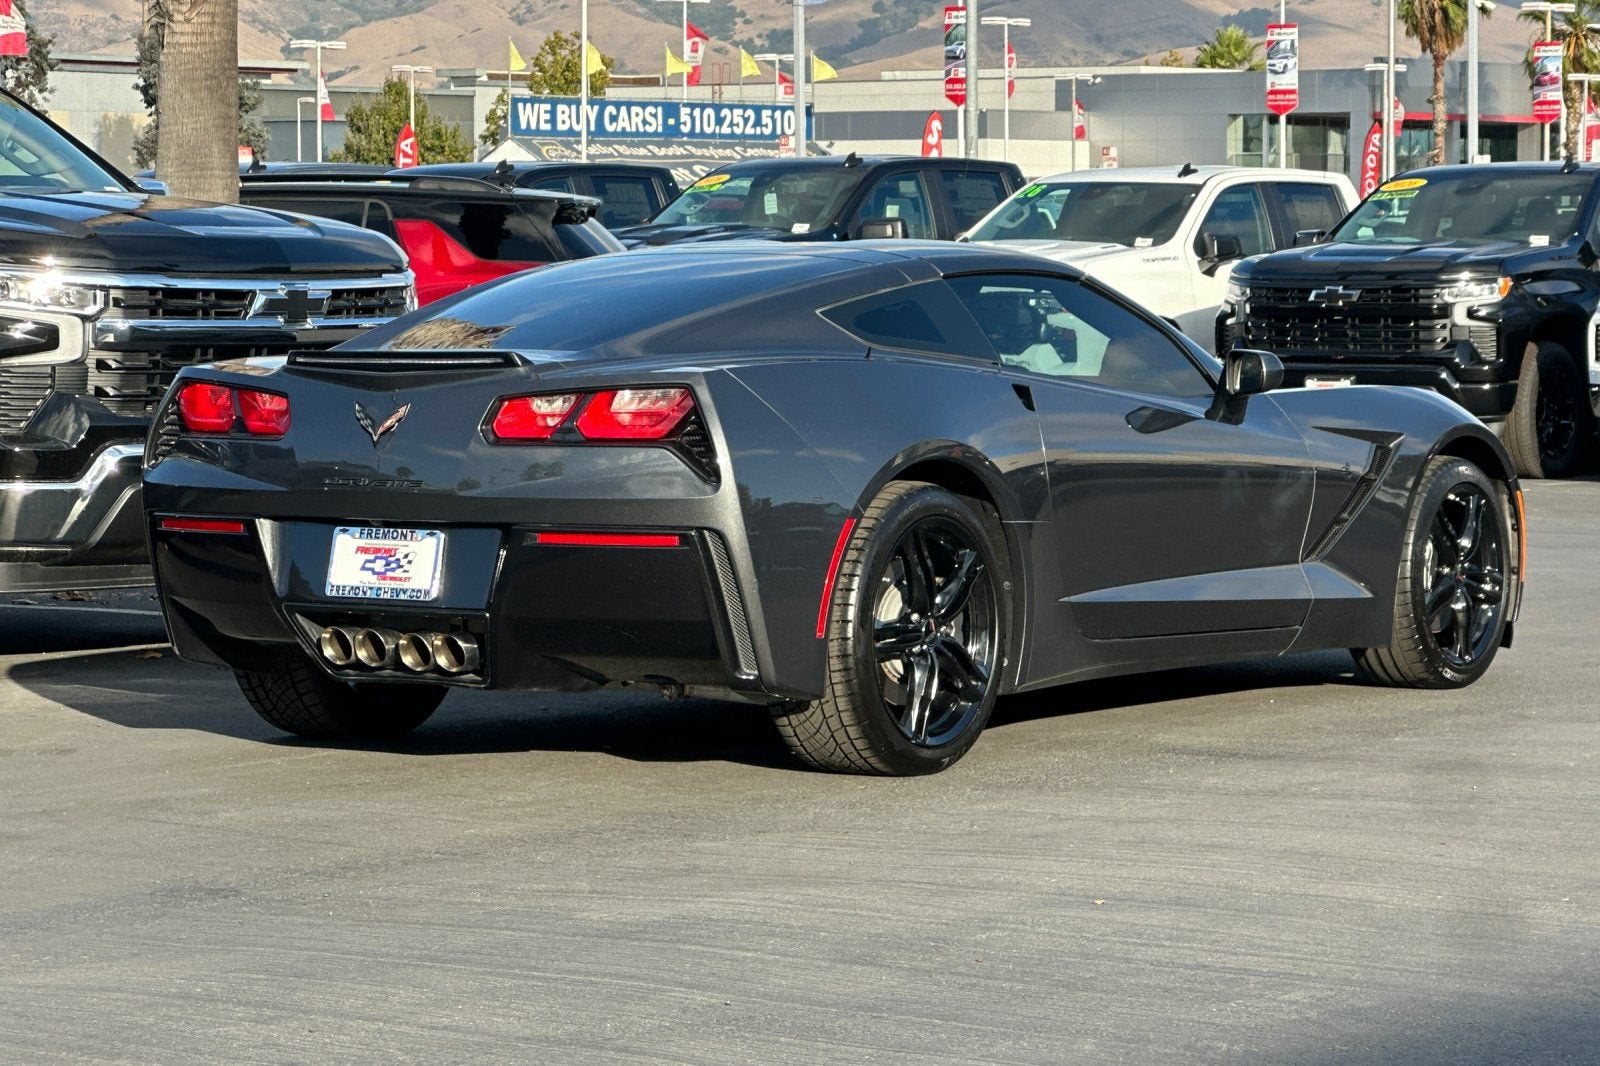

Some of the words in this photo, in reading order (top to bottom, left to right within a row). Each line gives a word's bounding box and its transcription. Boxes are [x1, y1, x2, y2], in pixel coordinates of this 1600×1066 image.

[518, 102, 551, 130] WE
[556, 103, 599, 131] BUY
[603, 105, 663, 133] CARS!
[680, 107, 796, 135] 510.252.510
[359, 529, 416, 541] FREMONT
[355, 546, 399, 556] FREMONT
